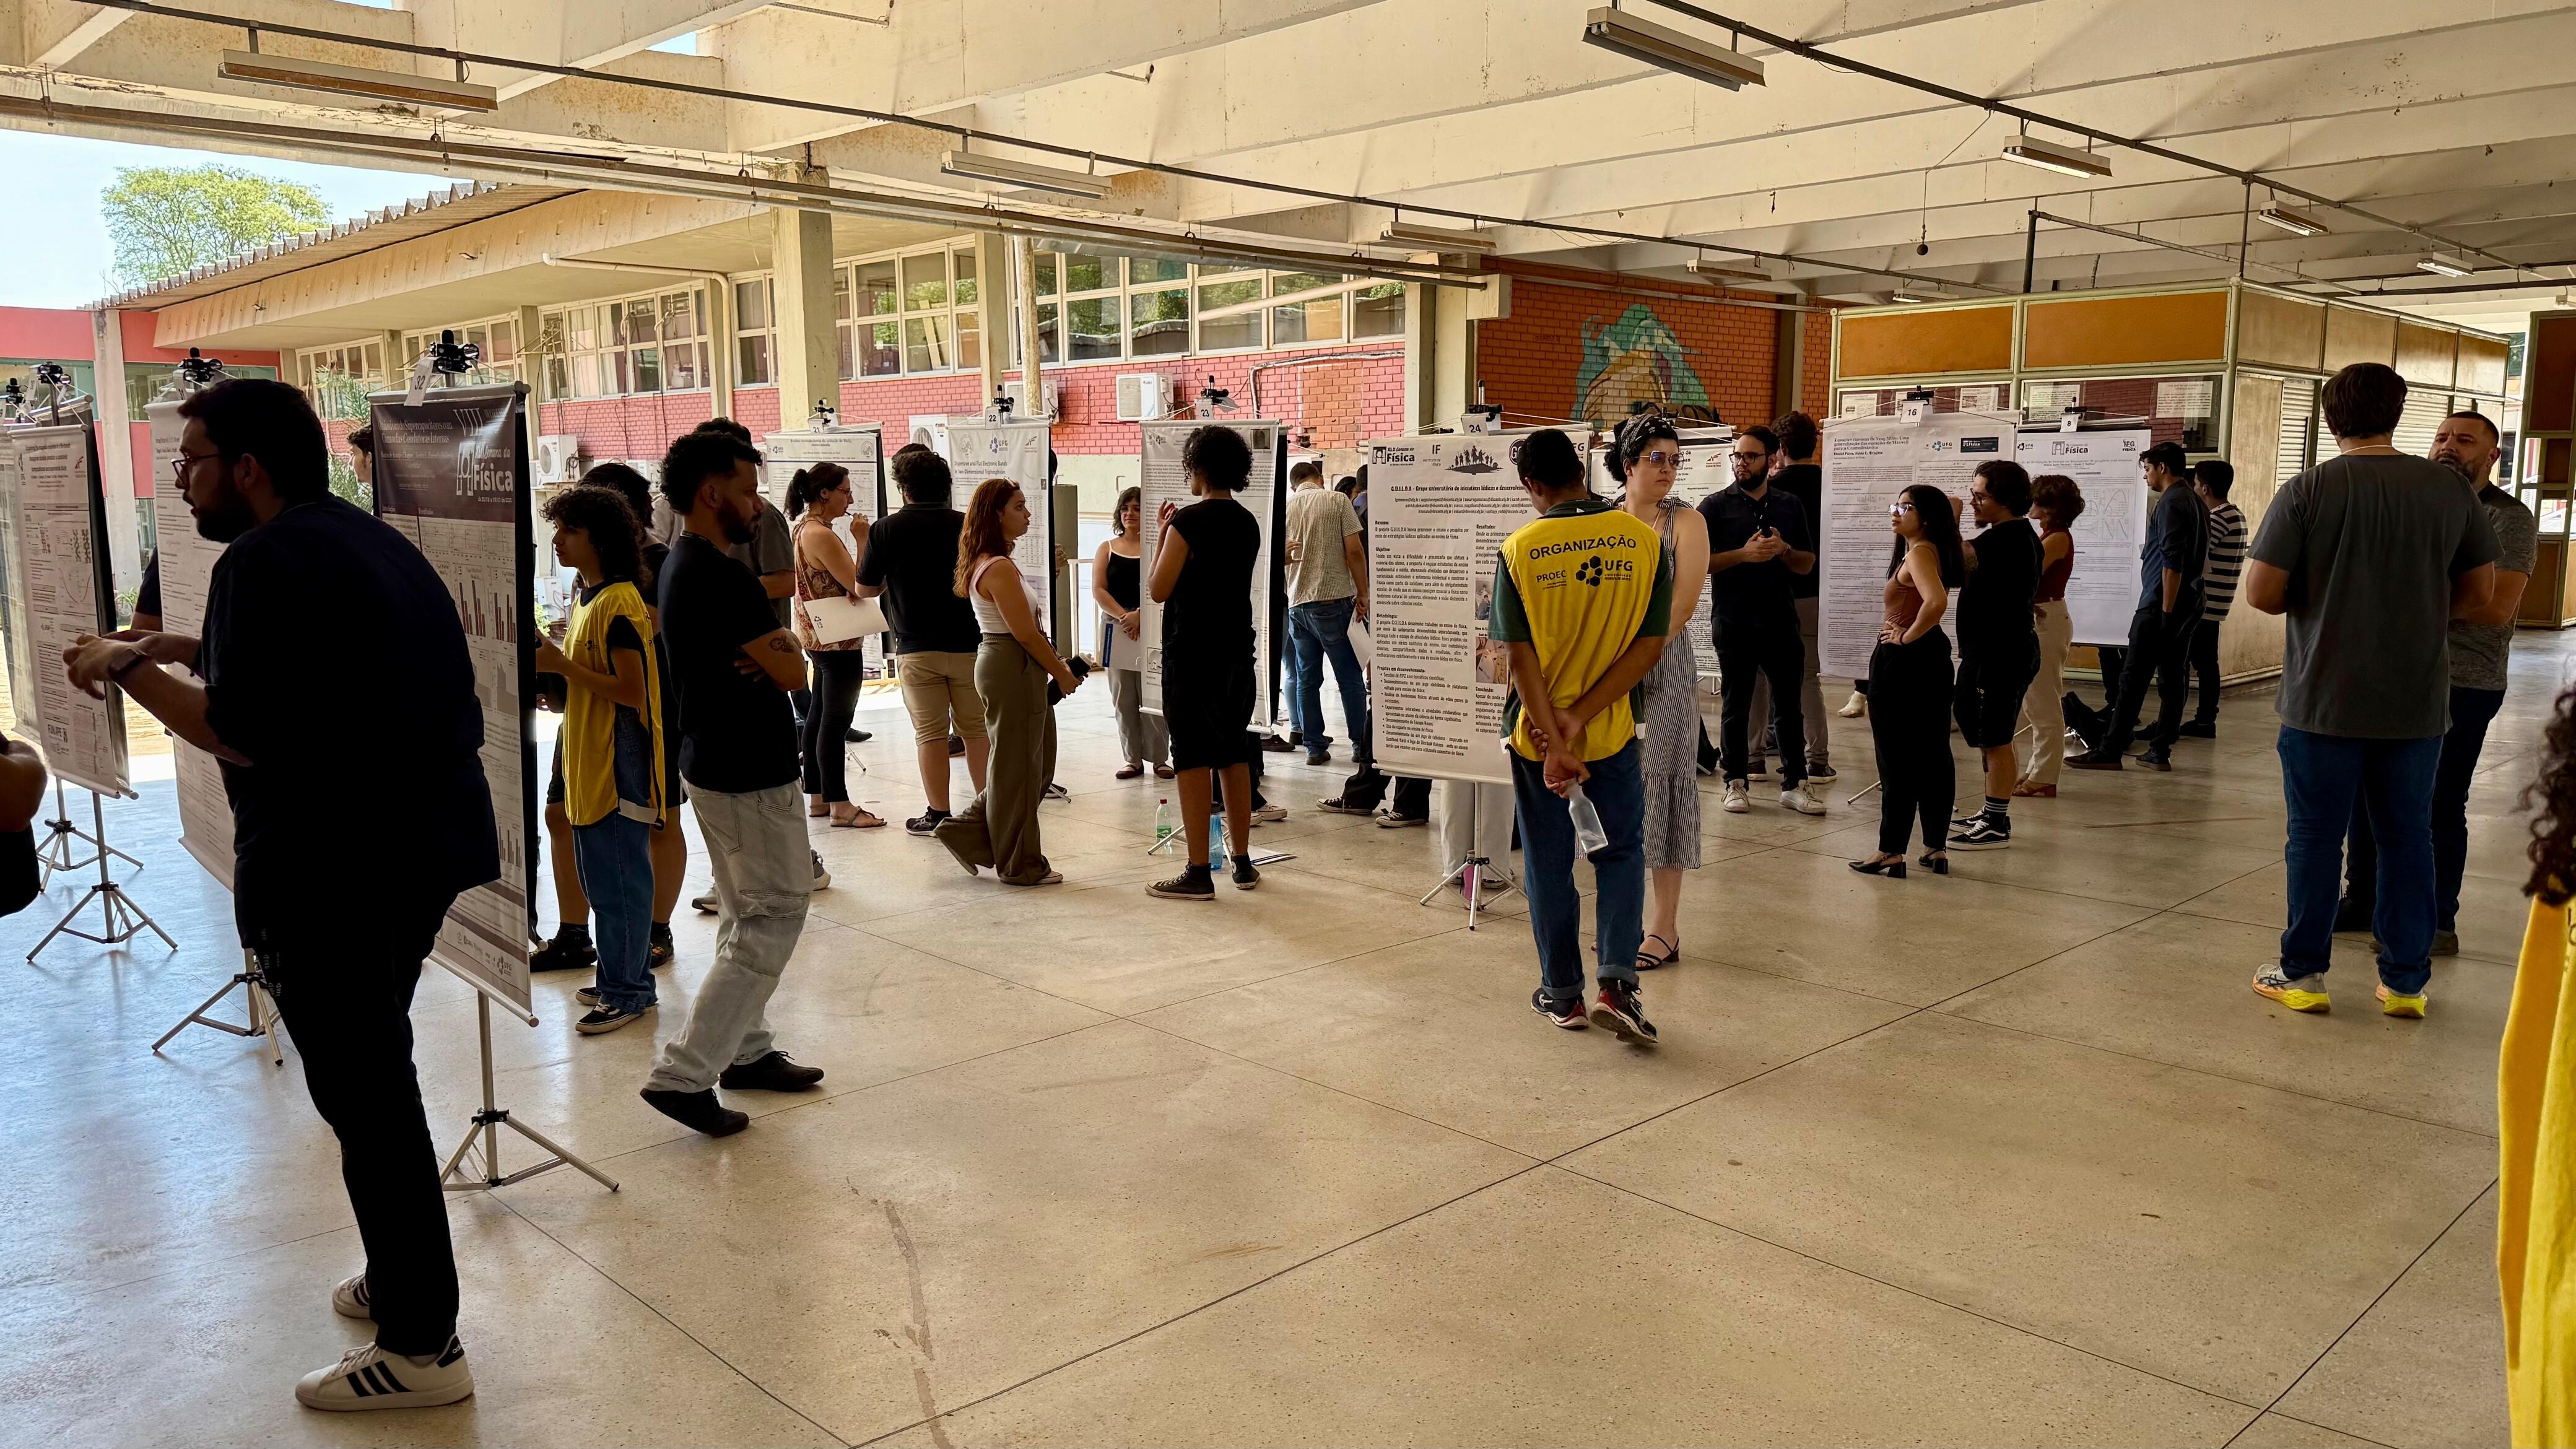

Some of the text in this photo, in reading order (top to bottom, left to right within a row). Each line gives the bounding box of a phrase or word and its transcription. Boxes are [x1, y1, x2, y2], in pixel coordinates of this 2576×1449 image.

[414, 375, 425, 390] 32
[1201, 409, 1210, 417] 23
[1469, 424, 1481, 433] 24
[1432, 445, 1441, 455] IF
[2065, 446, 2089, 454] Física
[1386, 453, 1415, 462] Física
[474, 463, 513, 492] Física
[1530, 534, 1637, 560] ORGANIZAÇÃO
[1605, 560, 1633, 571] UFG
[1536, 570, 1566, 583] PROEC
